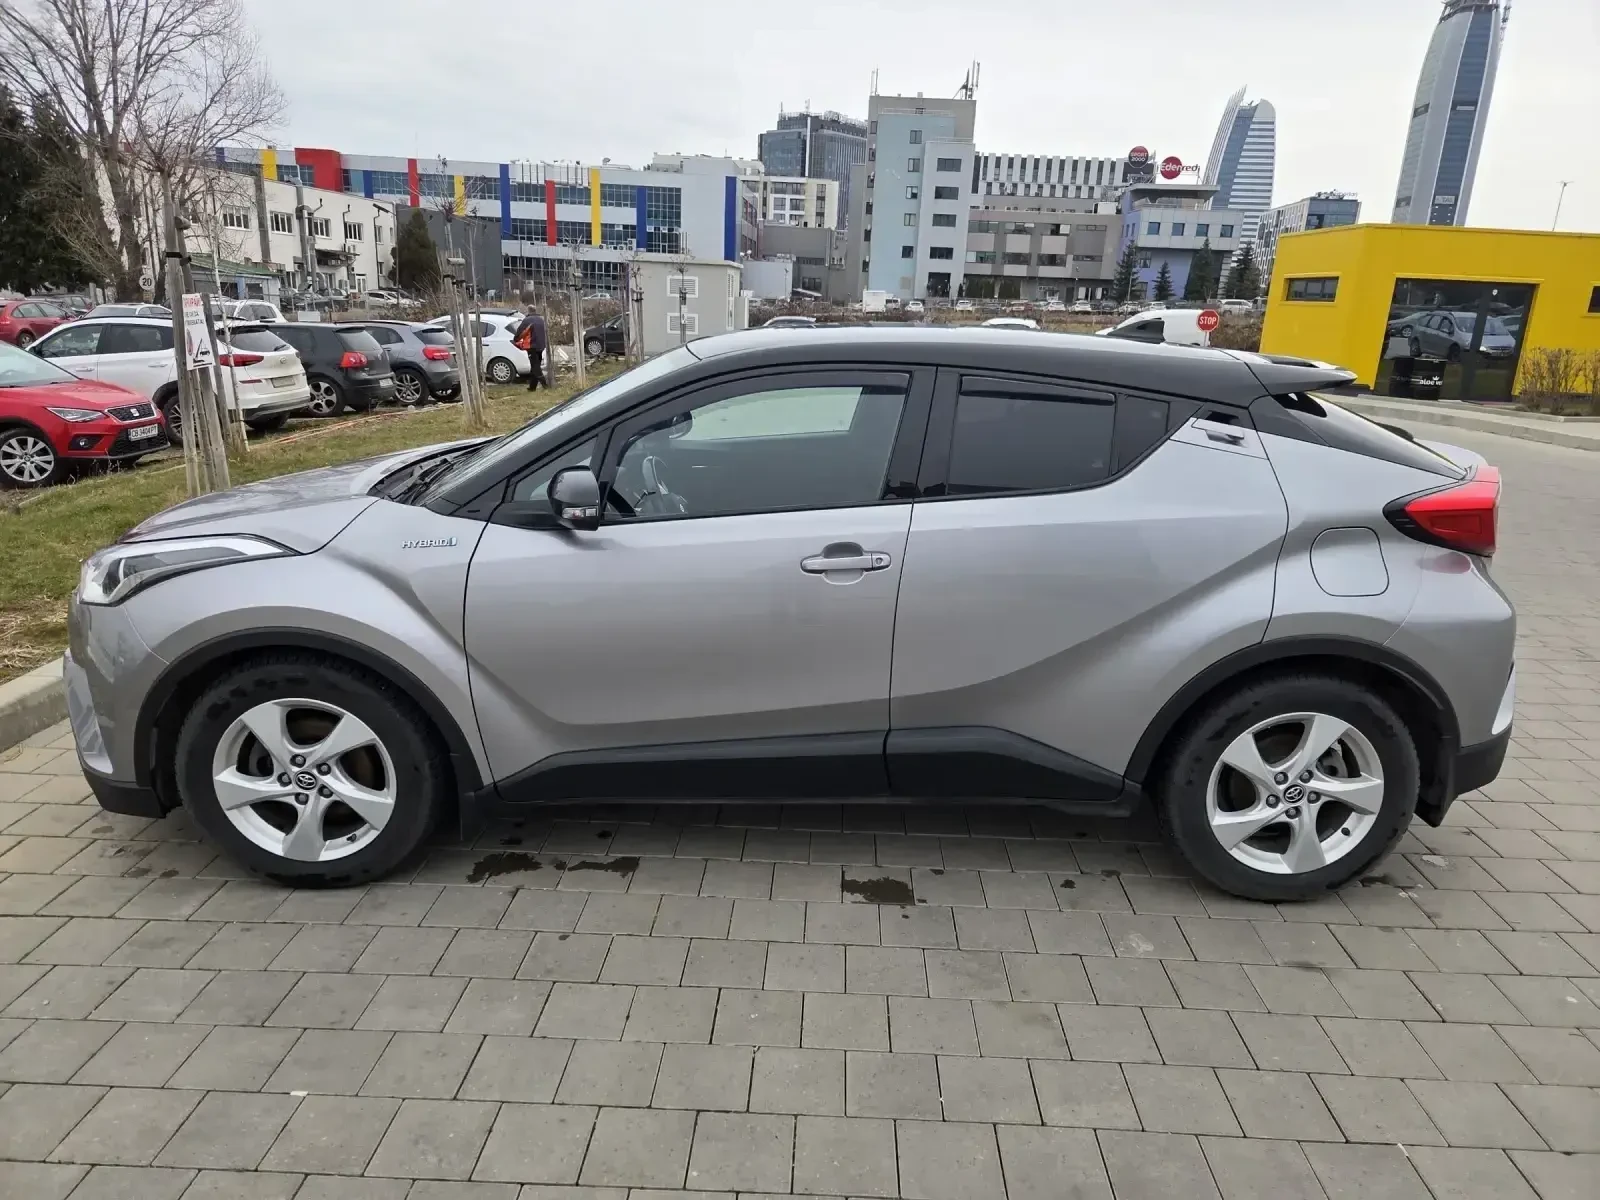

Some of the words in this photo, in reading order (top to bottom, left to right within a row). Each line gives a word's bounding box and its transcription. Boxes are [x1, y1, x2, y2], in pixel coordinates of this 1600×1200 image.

[1160, 162, 1199, 172] Edenred
[142, 277, 152, 287] 20
[1199, 316, 1217, 325] STOP
[402, 538, 448, 549] HYBRID
